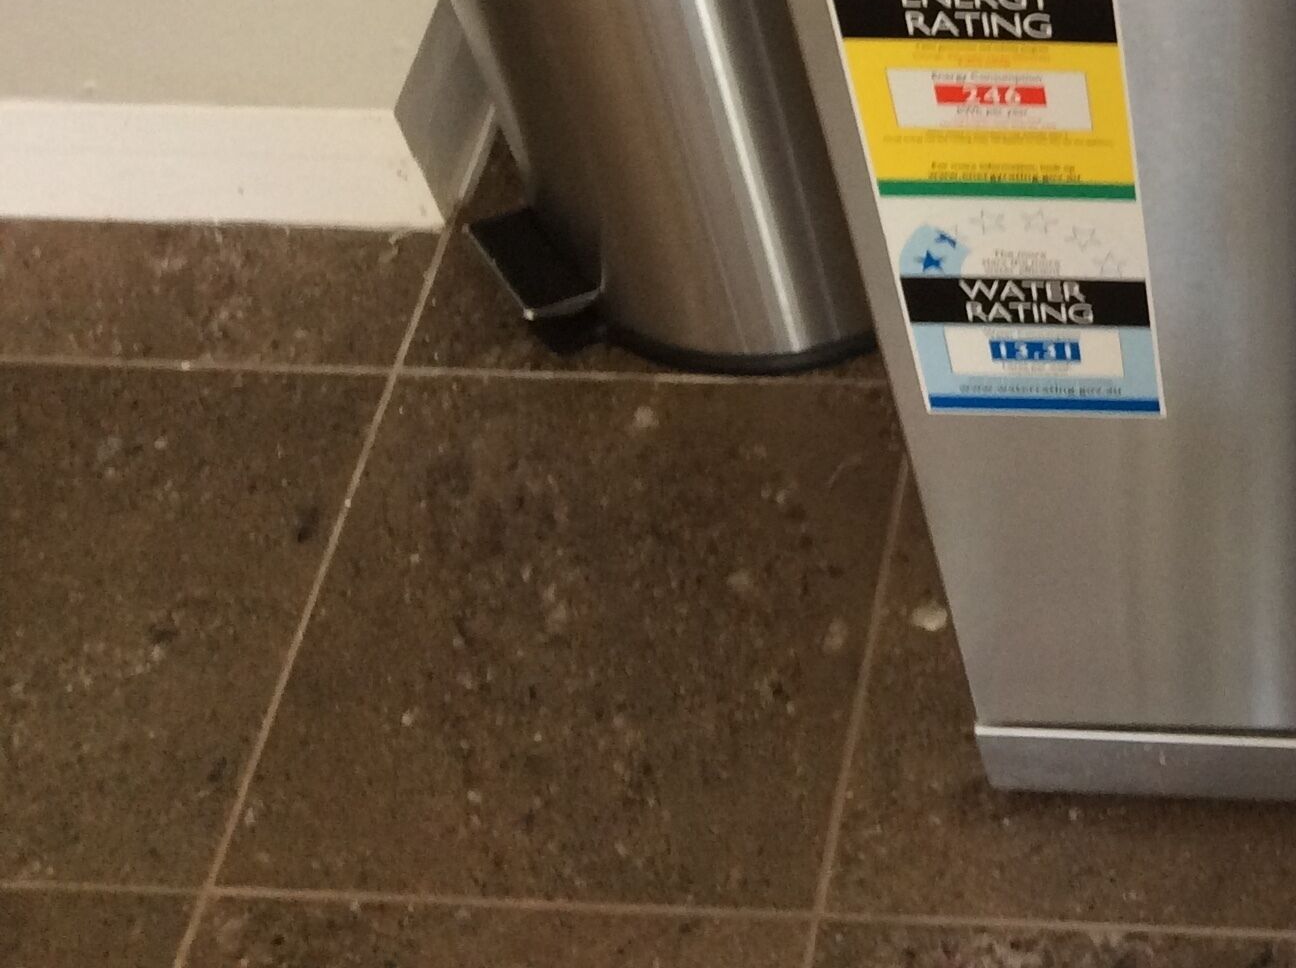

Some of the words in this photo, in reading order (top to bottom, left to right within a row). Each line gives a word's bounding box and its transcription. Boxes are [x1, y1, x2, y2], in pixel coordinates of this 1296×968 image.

[905, 10, 1052, 39] RATING
[962, 84, 1021, 106] 246
[959, 279, 1086, 303] WATER
[965, 301, 1094, 325] RATING
